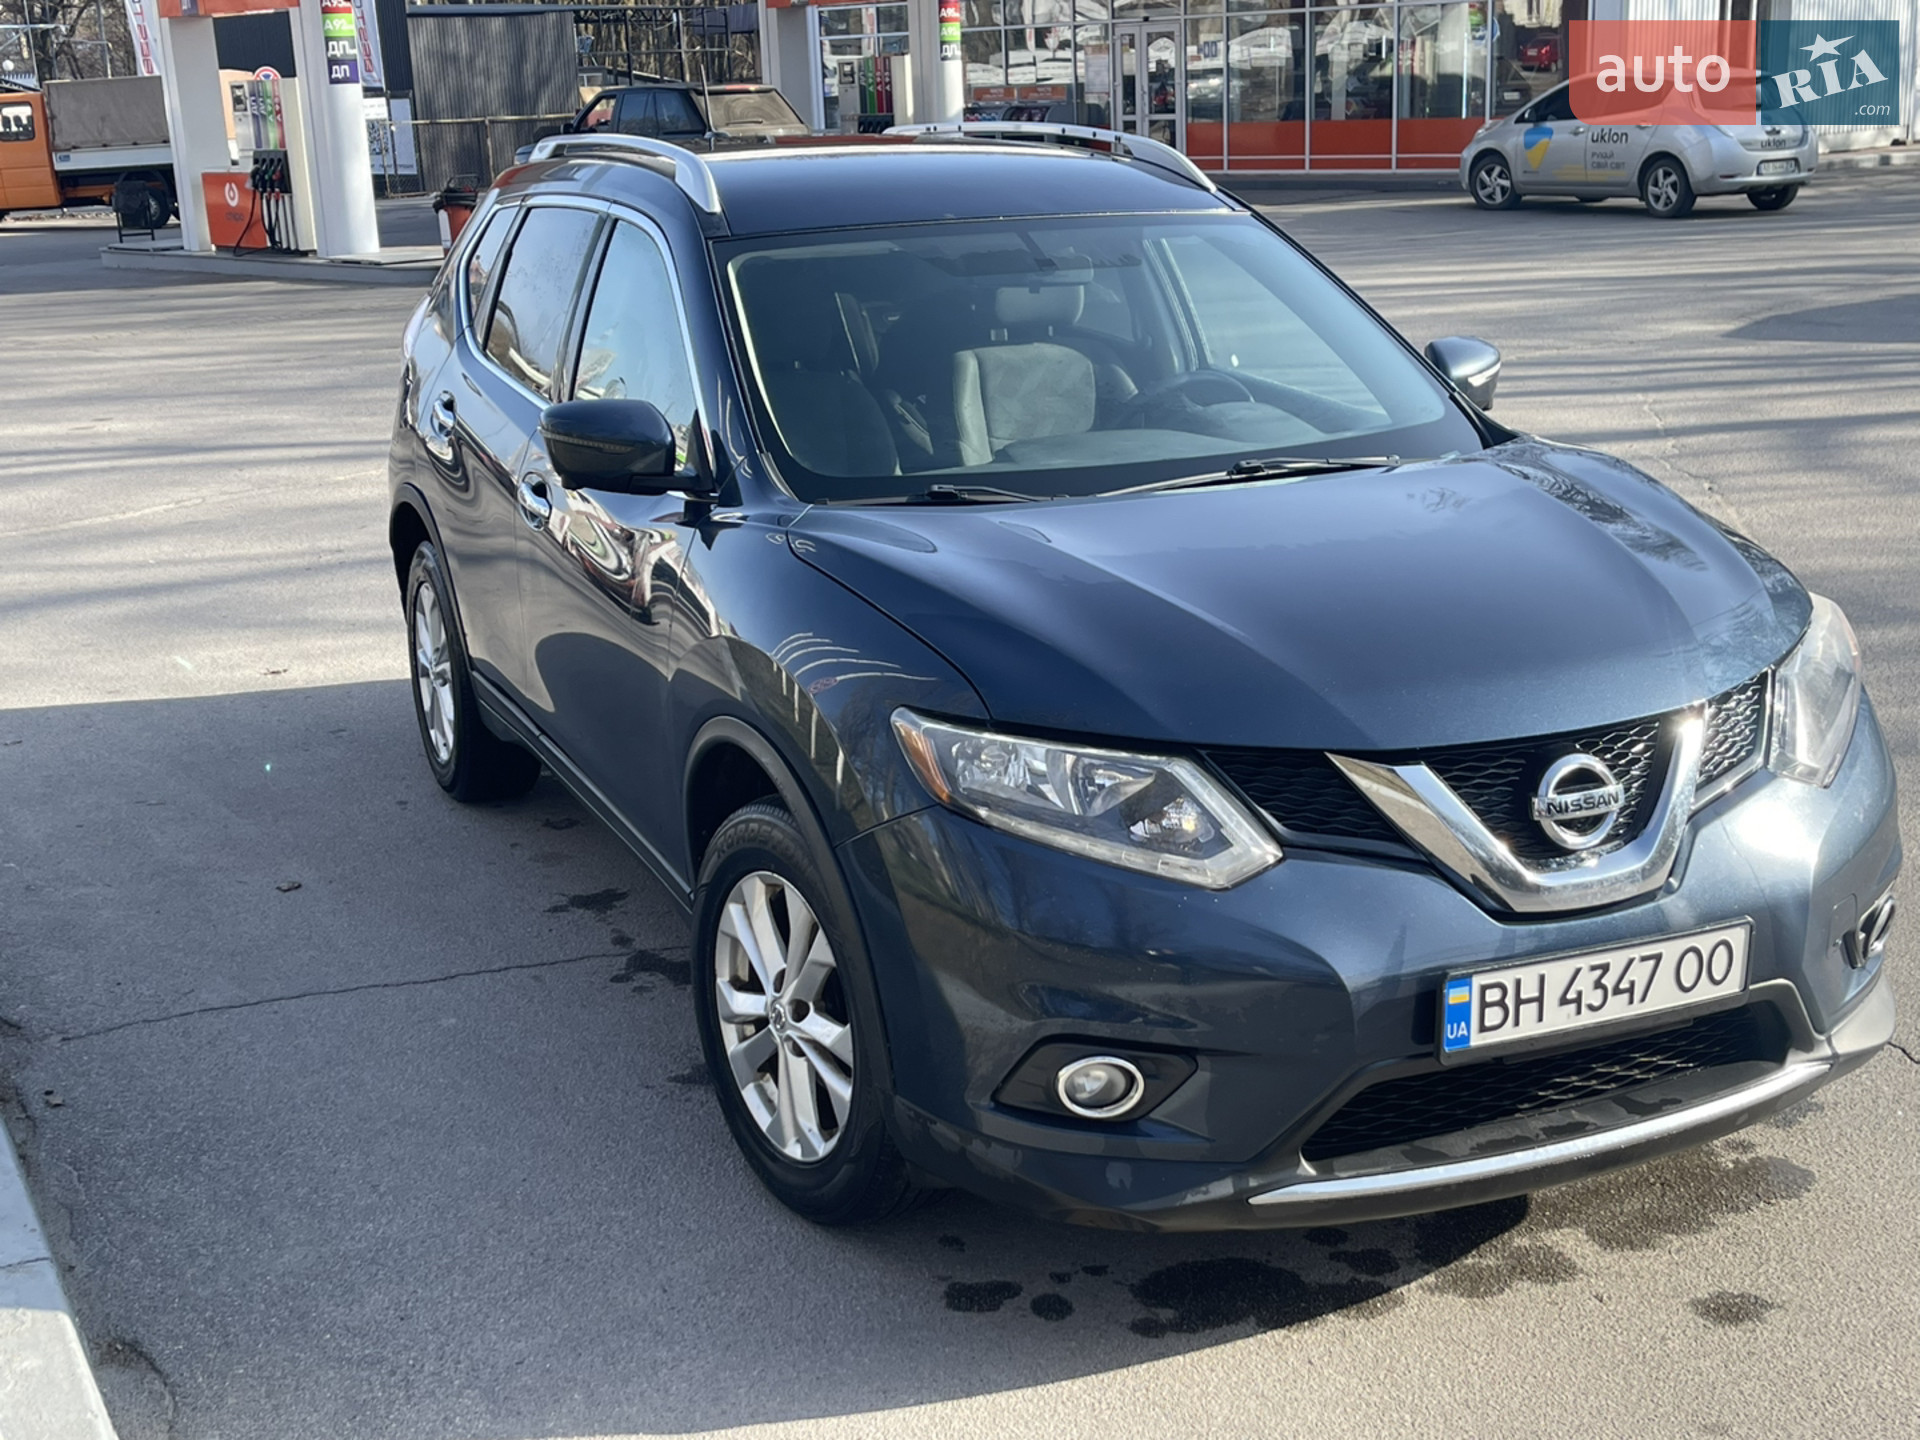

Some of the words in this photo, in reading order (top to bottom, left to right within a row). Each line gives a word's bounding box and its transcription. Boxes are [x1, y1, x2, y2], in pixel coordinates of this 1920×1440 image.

[327, 40, 349, 58] ДП
[331, 65, 350, 80] ДП
[1591, 127, 1629, 144] uklon
[1760, 138, 1786, 148] uklon
[1546, 791, 1620, 815] NISSAN
[1477, 973, 1546, 1034] BH
[1558, 951, 1663, 1016] 4347
[1447, 1021, 1468, 1039] UA
